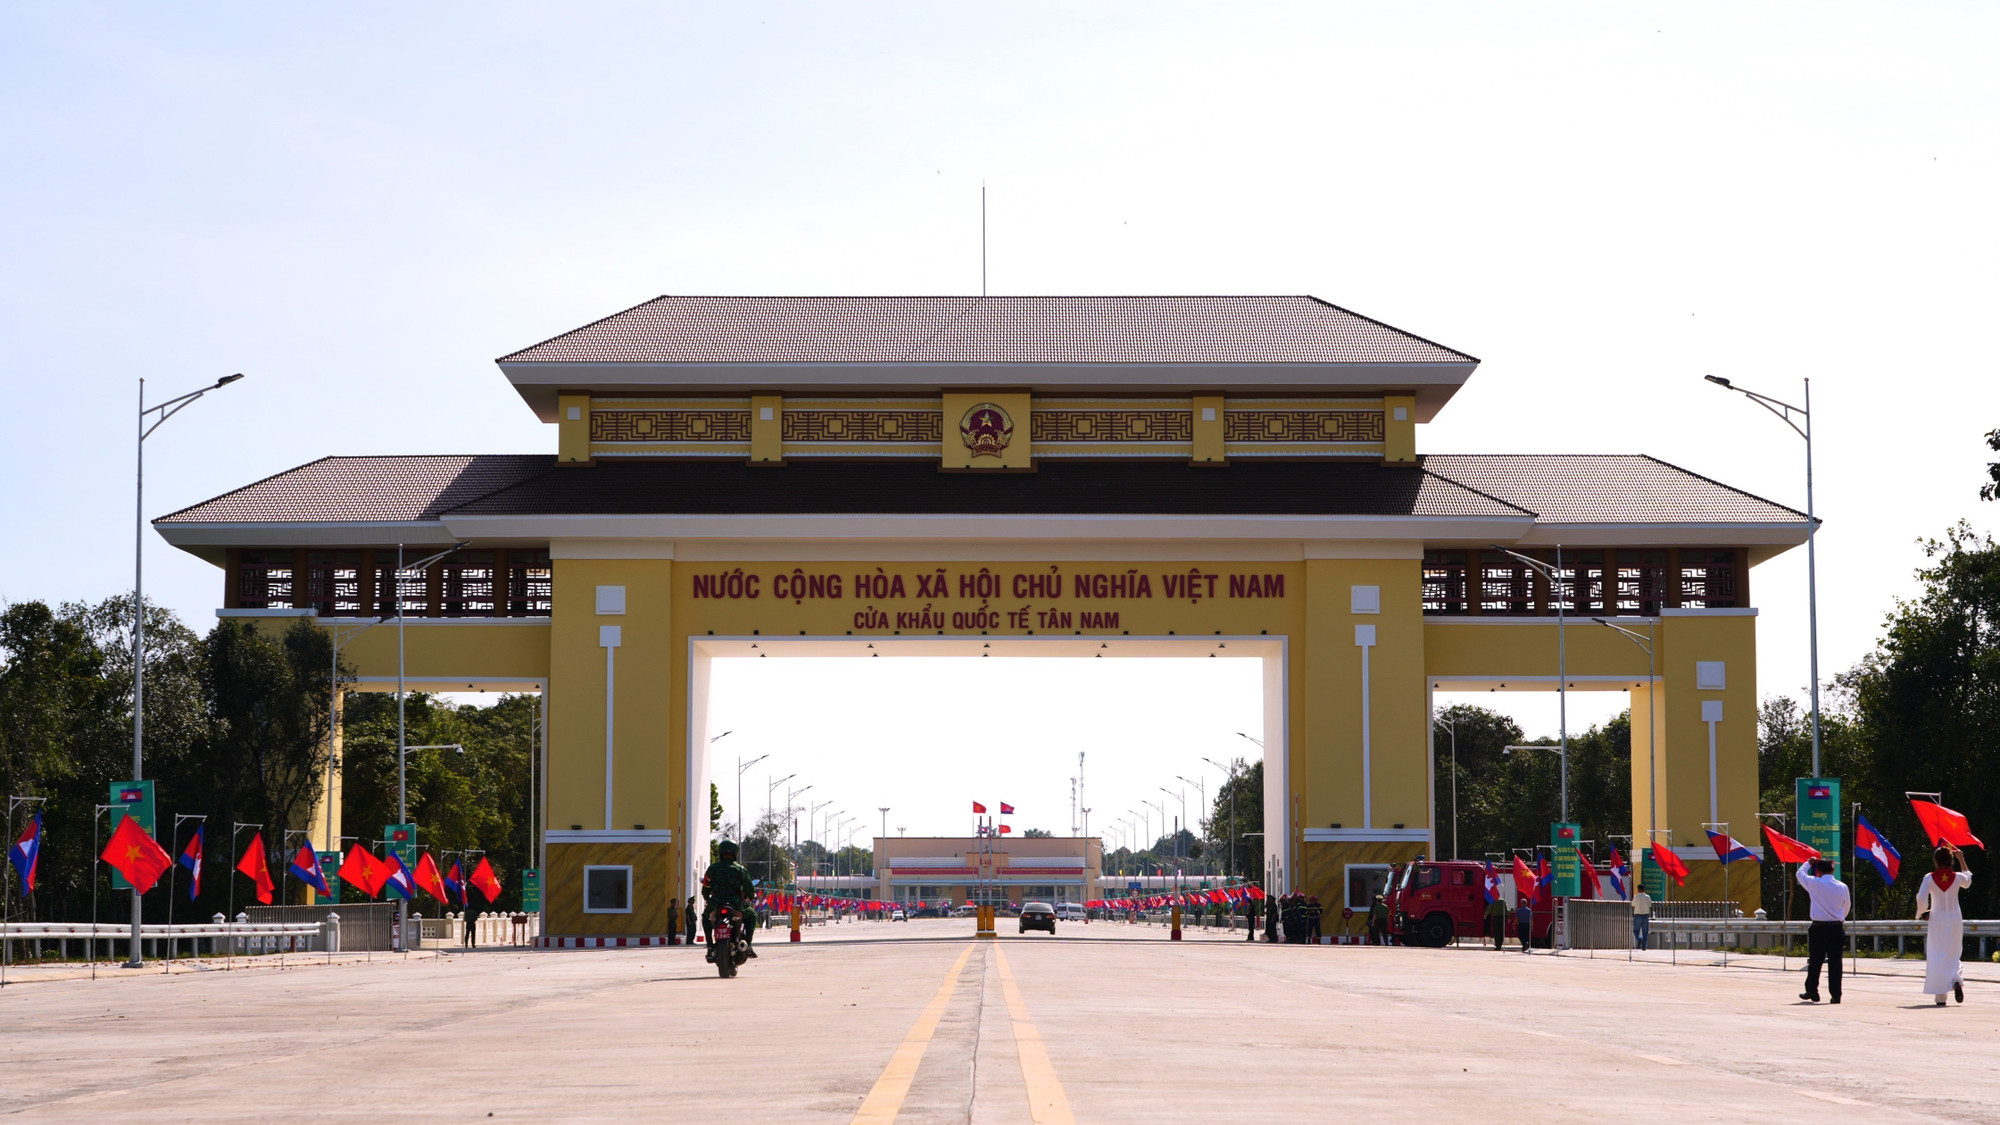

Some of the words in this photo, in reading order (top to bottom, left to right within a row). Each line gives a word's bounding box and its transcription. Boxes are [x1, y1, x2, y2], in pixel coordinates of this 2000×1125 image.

[693, 568, 759, 599] NƯỚC
[774, 568, 842, 604] CỘNG
[856, 568, 906, 599] HÒA
[917, 568, 949, 599] XÃ
[960, 568, 1000, 604] HỘI
[1013, 565, 1062, 599] CHỦ
[1075, 569, 1152, 599] NGHĨA
[1162, 568, 1219, 604] VIỆT
[1230, 574, 1285, 599] NAM
[854, 606, 889, 629] CỬA
[897, 604, 945, 629] KHẨU
[953, 605, 999, 630] QUỐC
[1008, 605, 1031, 629] TẾ
[1037, 608, 1072, 629] TÂN
[1081, 612, 1120, 629] NAM
